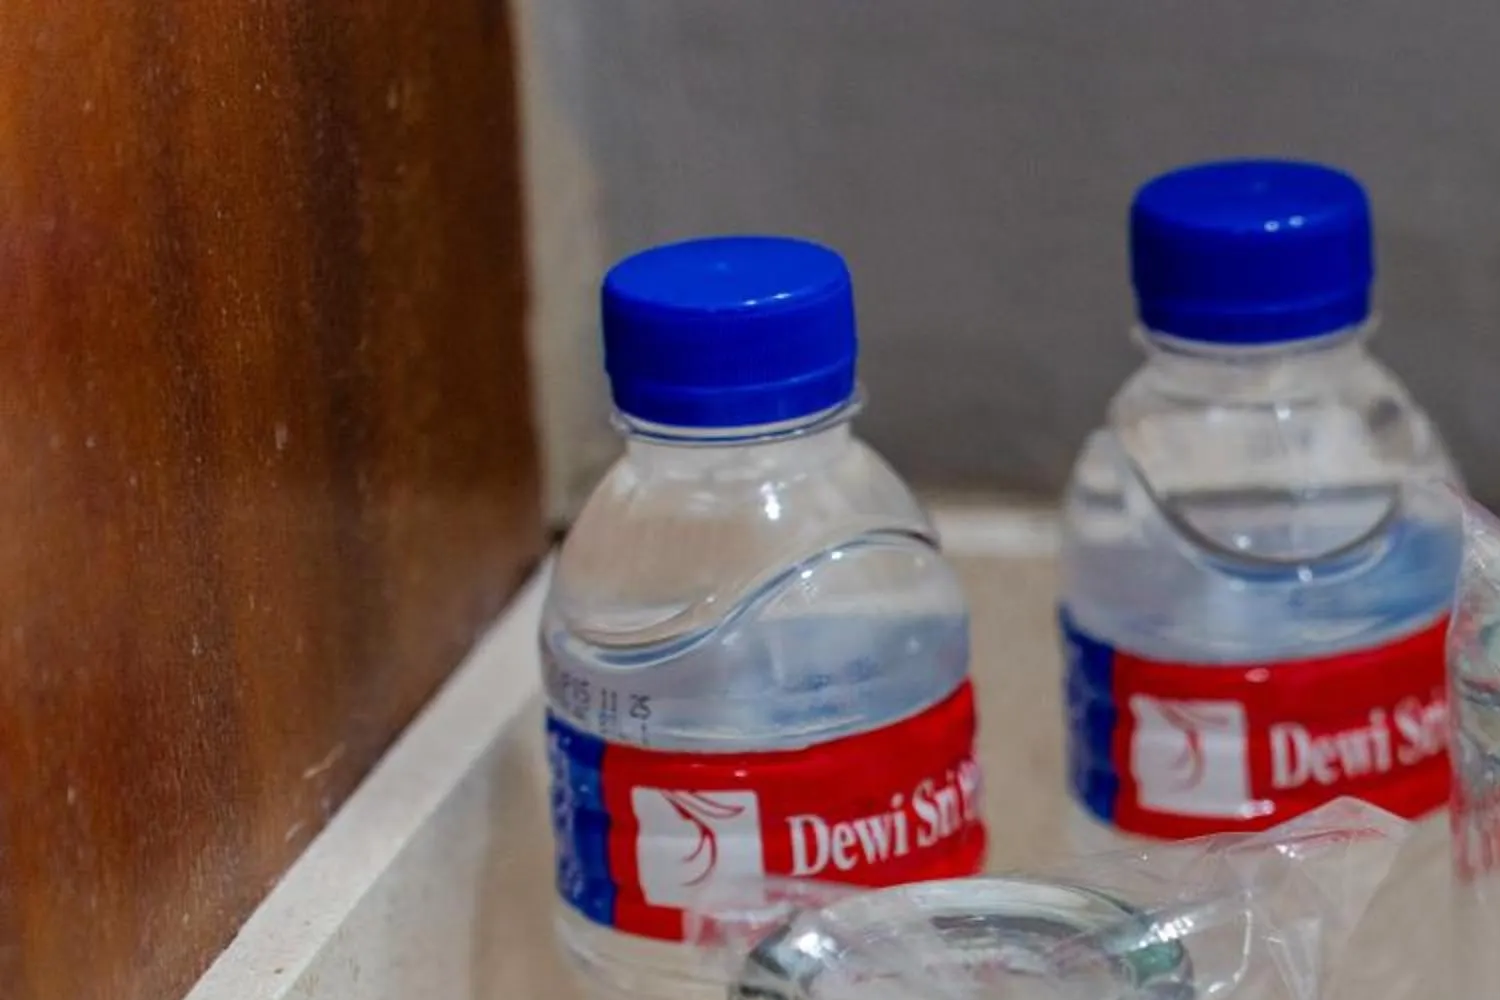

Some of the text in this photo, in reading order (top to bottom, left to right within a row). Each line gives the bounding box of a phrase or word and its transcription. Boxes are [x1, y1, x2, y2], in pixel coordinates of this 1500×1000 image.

[1269, 705, 1392, 790] Dewi
[786, 792, 910, 877] Dewi
[912, 768, 960, 848] Sri
